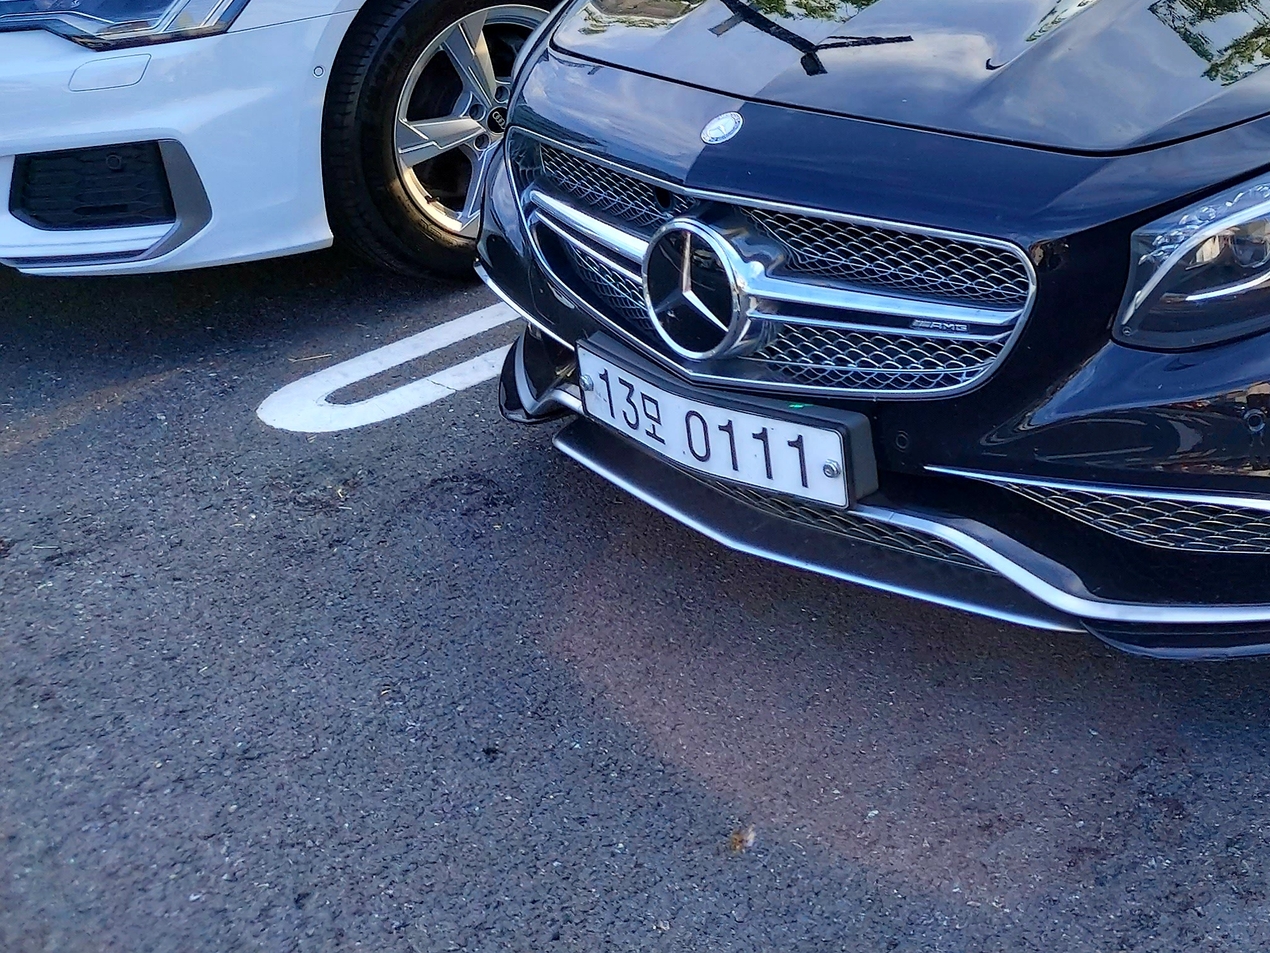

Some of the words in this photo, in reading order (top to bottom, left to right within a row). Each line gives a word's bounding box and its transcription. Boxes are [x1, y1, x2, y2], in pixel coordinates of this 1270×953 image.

[930, 321, 968, 331] AMG
[599, 368, 666, 446] 13모
[684, 409, 810, 489] 0111
